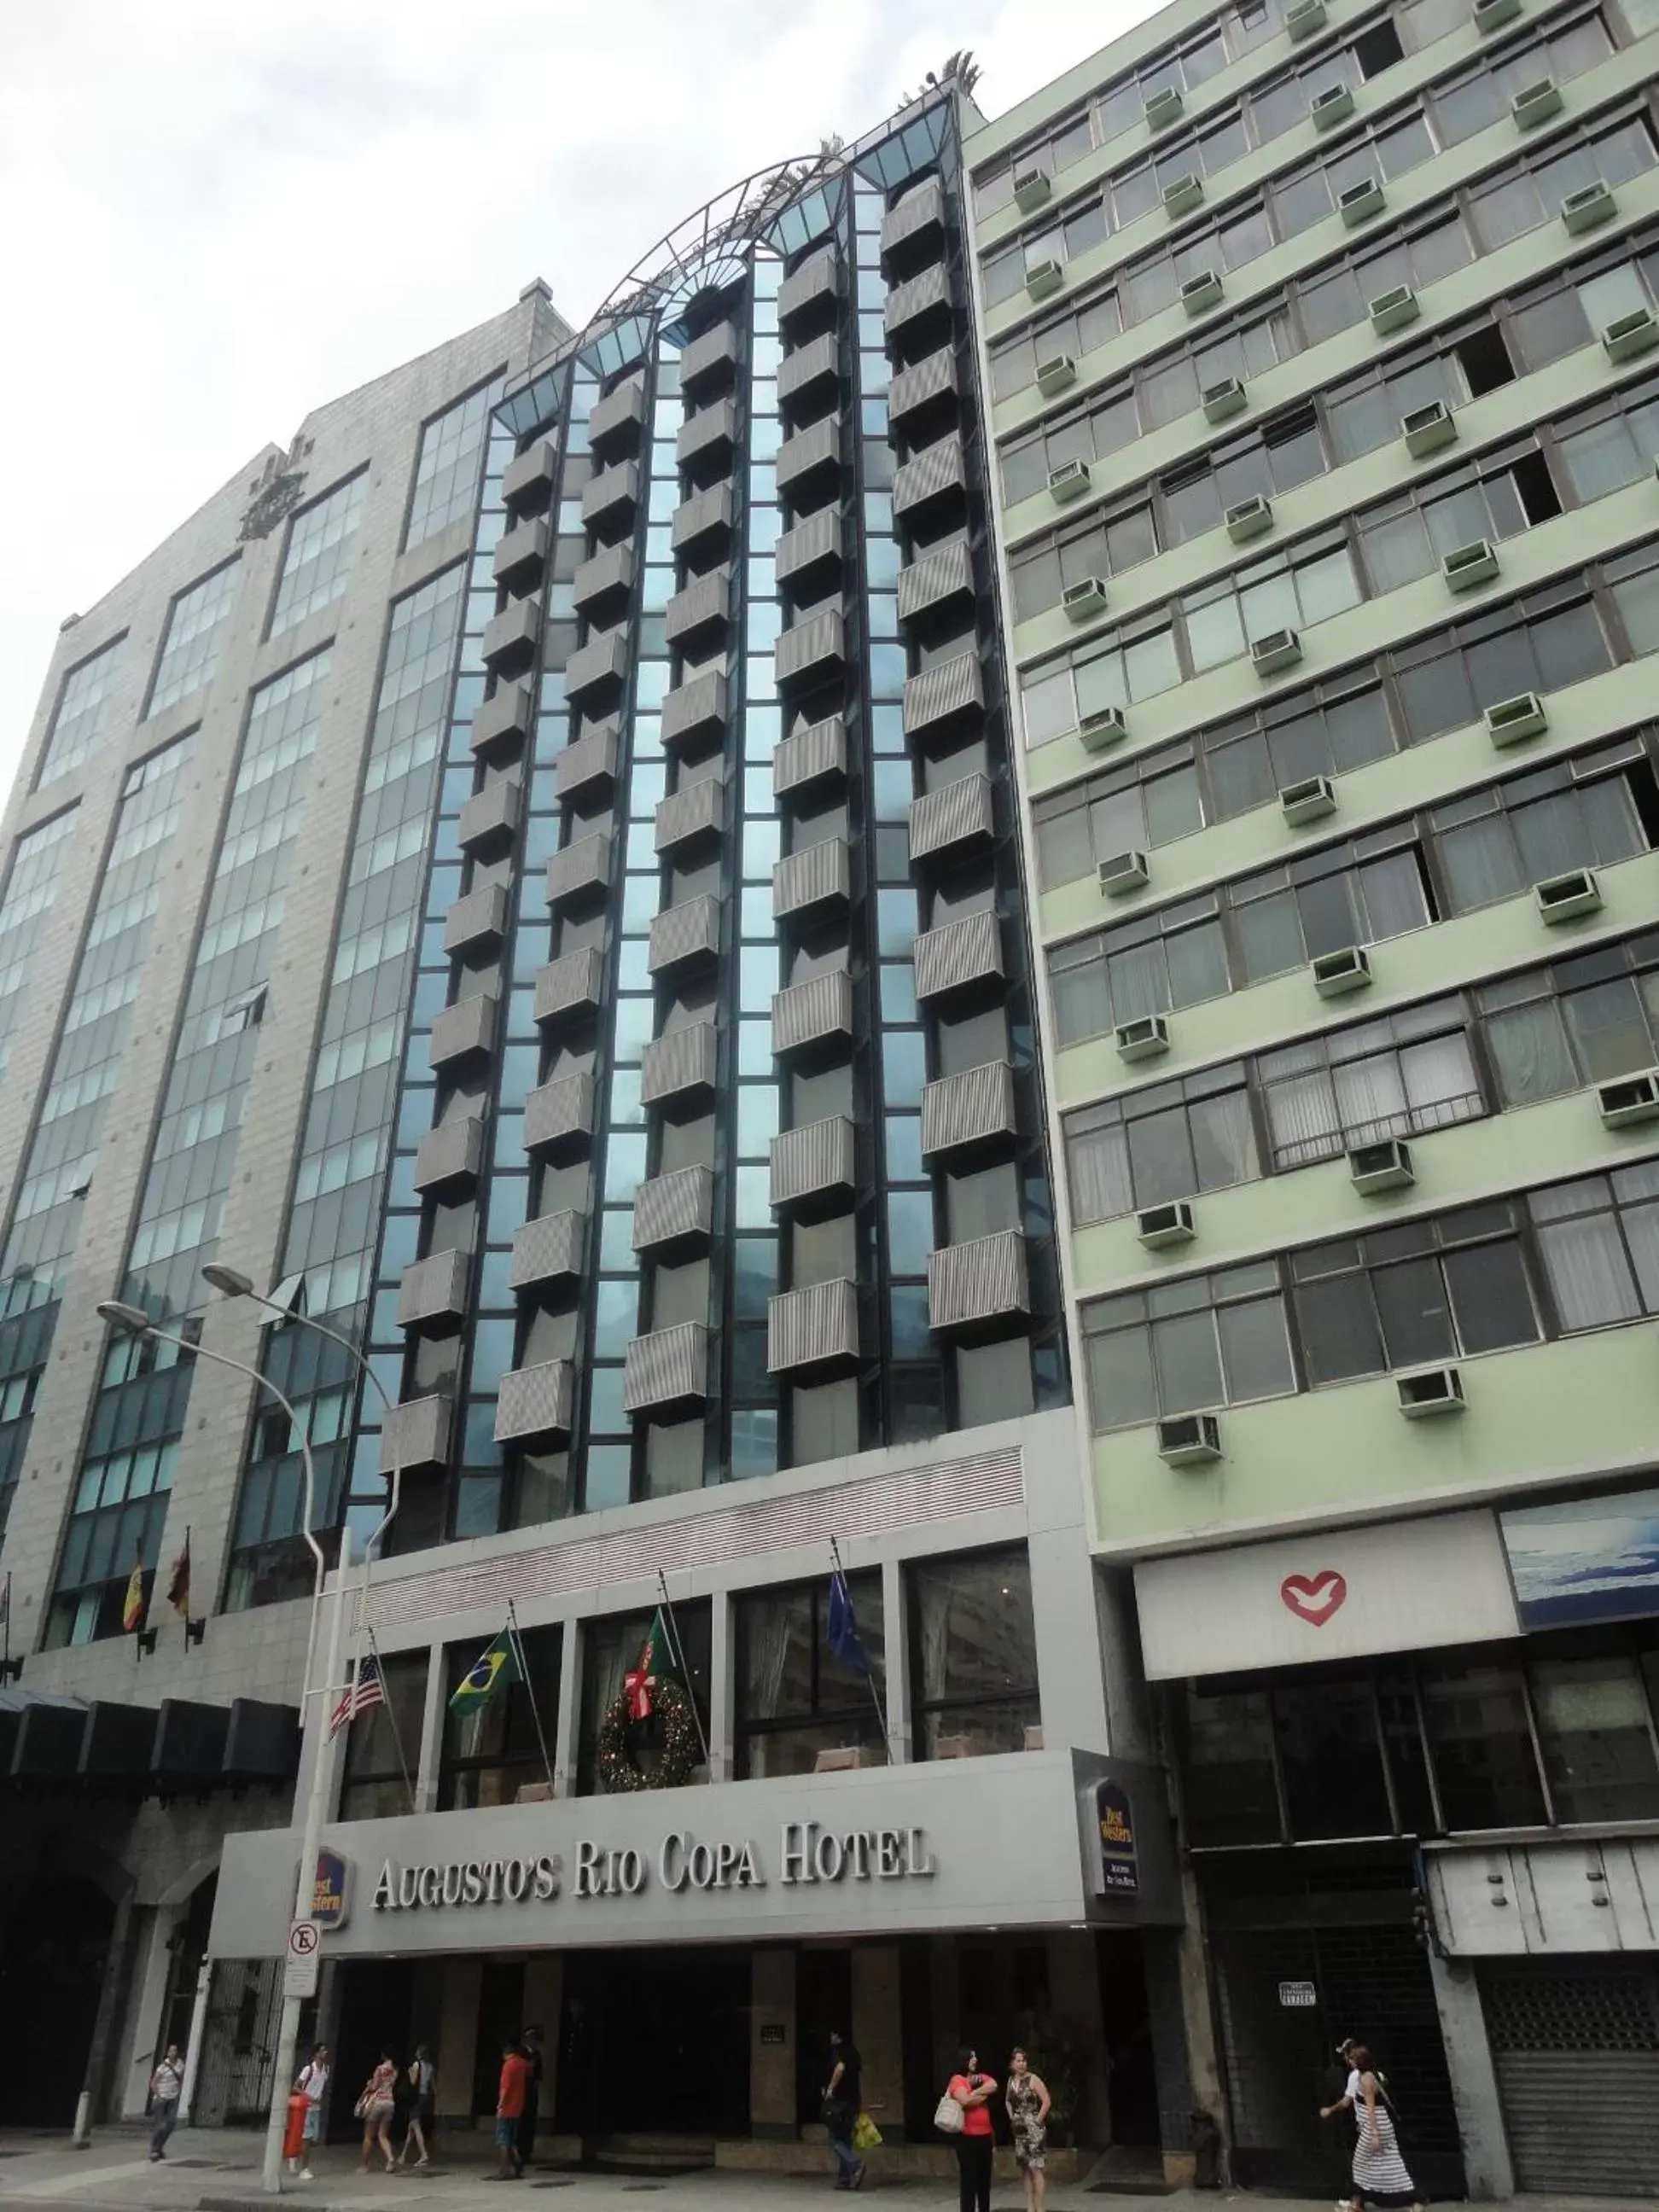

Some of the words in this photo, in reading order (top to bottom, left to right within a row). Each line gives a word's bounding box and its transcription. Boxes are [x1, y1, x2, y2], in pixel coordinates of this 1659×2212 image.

[370, 1856, 554, 1908] AUGUSTO'S
[572, 1840, 643, 1895] RIO
[659, 1831, 765, 1890] COPA
[778, 1821, 936, 1883] HOTEL
